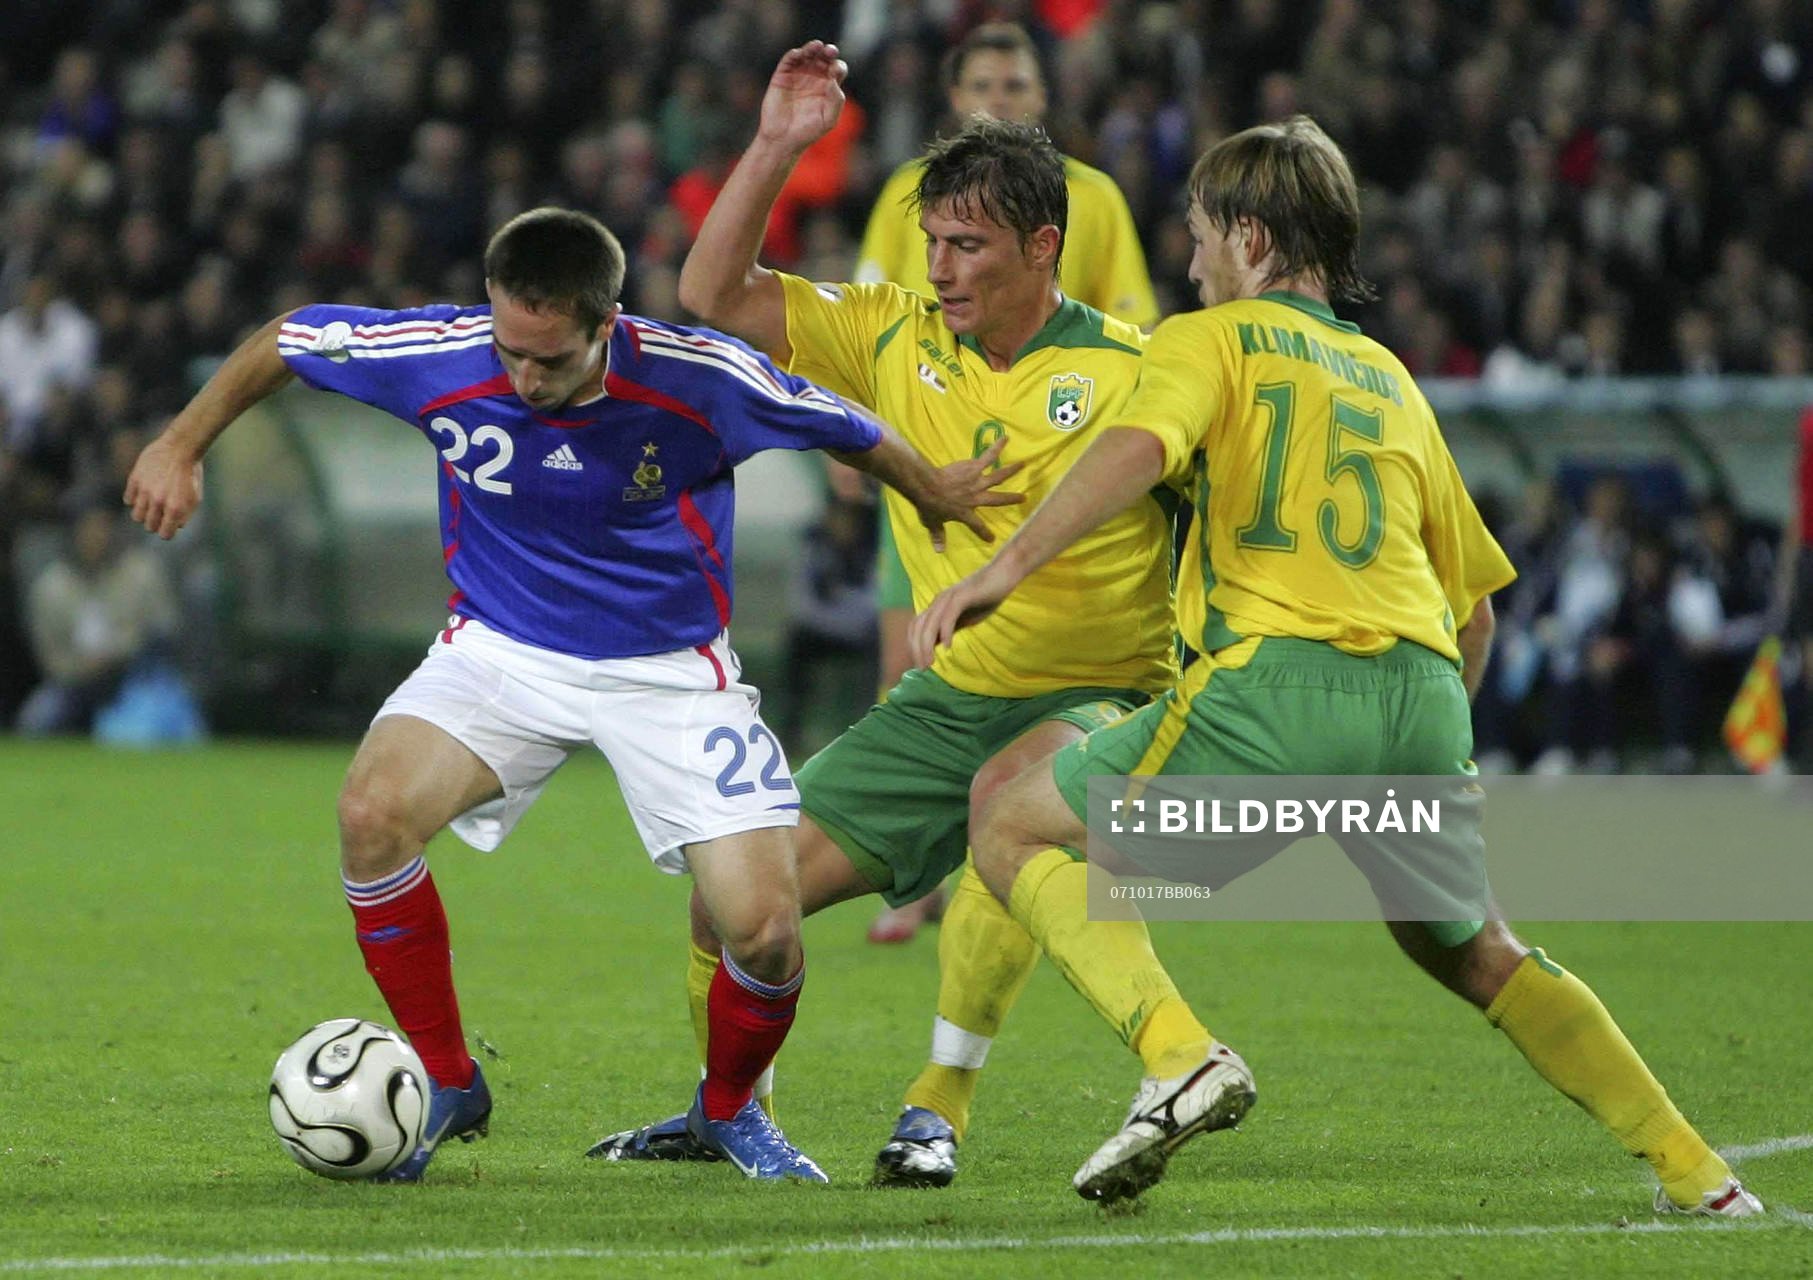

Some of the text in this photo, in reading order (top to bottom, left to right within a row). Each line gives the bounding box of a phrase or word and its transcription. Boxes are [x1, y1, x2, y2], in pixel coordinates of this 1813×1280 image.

[430, 416, 514, 495] 22
[542, 459, 583, 471] adidas
[1236, 381, 1386, 571] 15
[703, 723, 793, 798] 22
